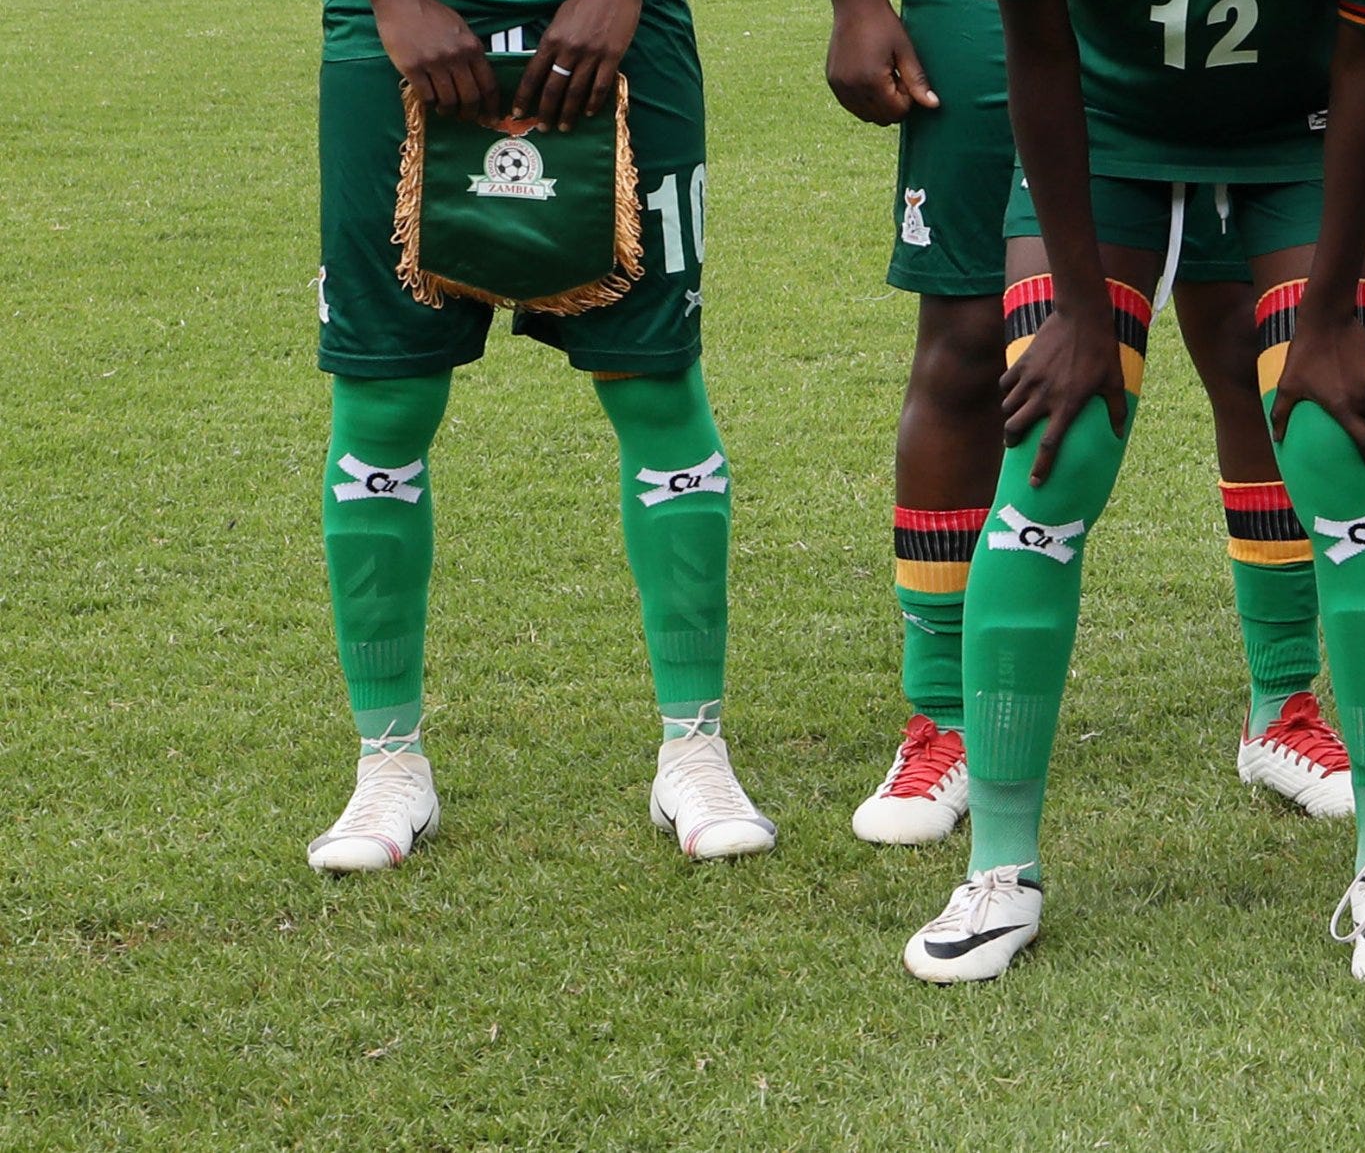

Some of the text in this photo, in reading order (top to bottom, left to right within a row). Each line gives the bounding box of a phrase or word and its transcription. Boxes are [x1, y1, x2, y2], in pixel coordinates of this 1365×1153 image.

[488, 184, 535, 195] ZAMBIA
[647, 163, 706, 273] 10
[366, 472, 398, 494] Cu
[669, 473, 701, 493] Cu
[1019, 526, 1053, 548] Cu
